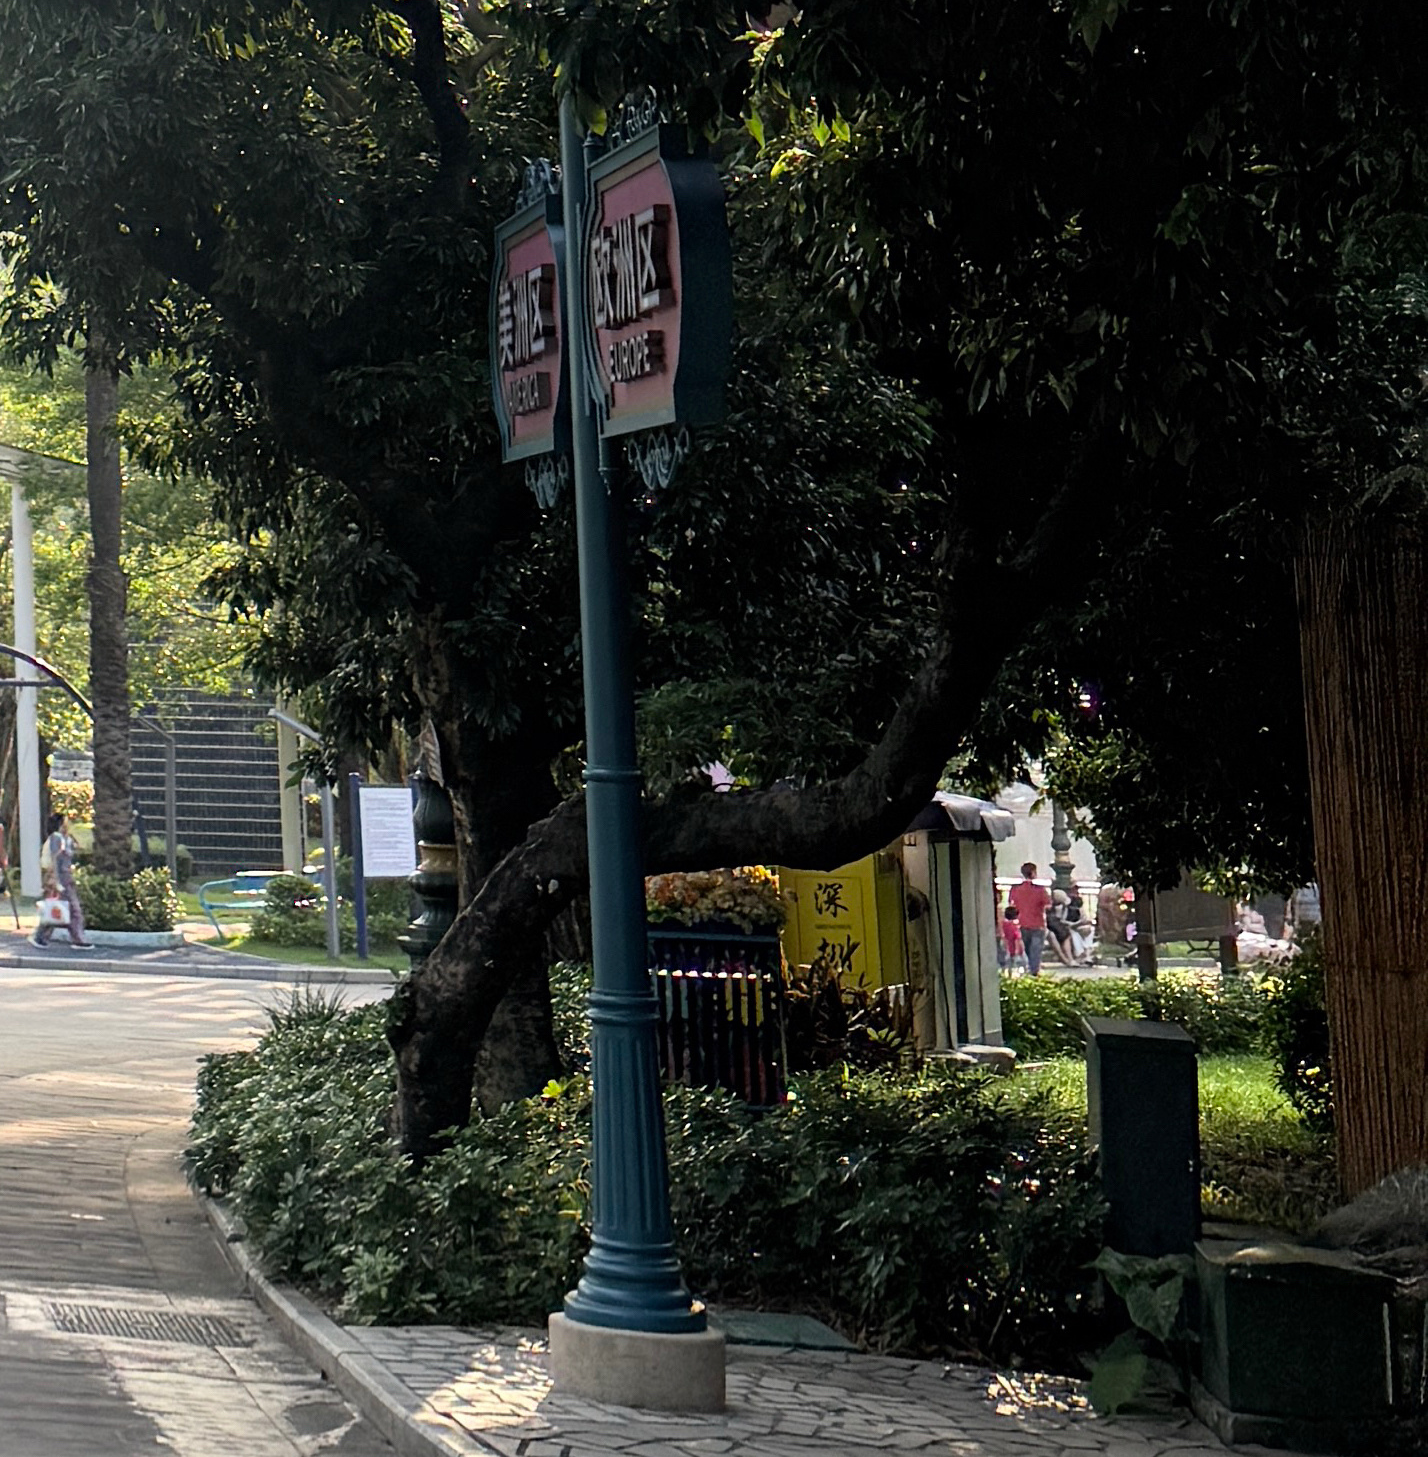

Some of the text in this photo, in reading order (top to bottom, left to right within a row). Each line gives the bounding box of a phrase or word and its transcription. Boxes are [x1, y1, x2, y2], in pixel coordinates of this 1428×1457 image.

[590, 208, 661, 328] 欧洲区
[608, 331, 652, 384] EUROPE
